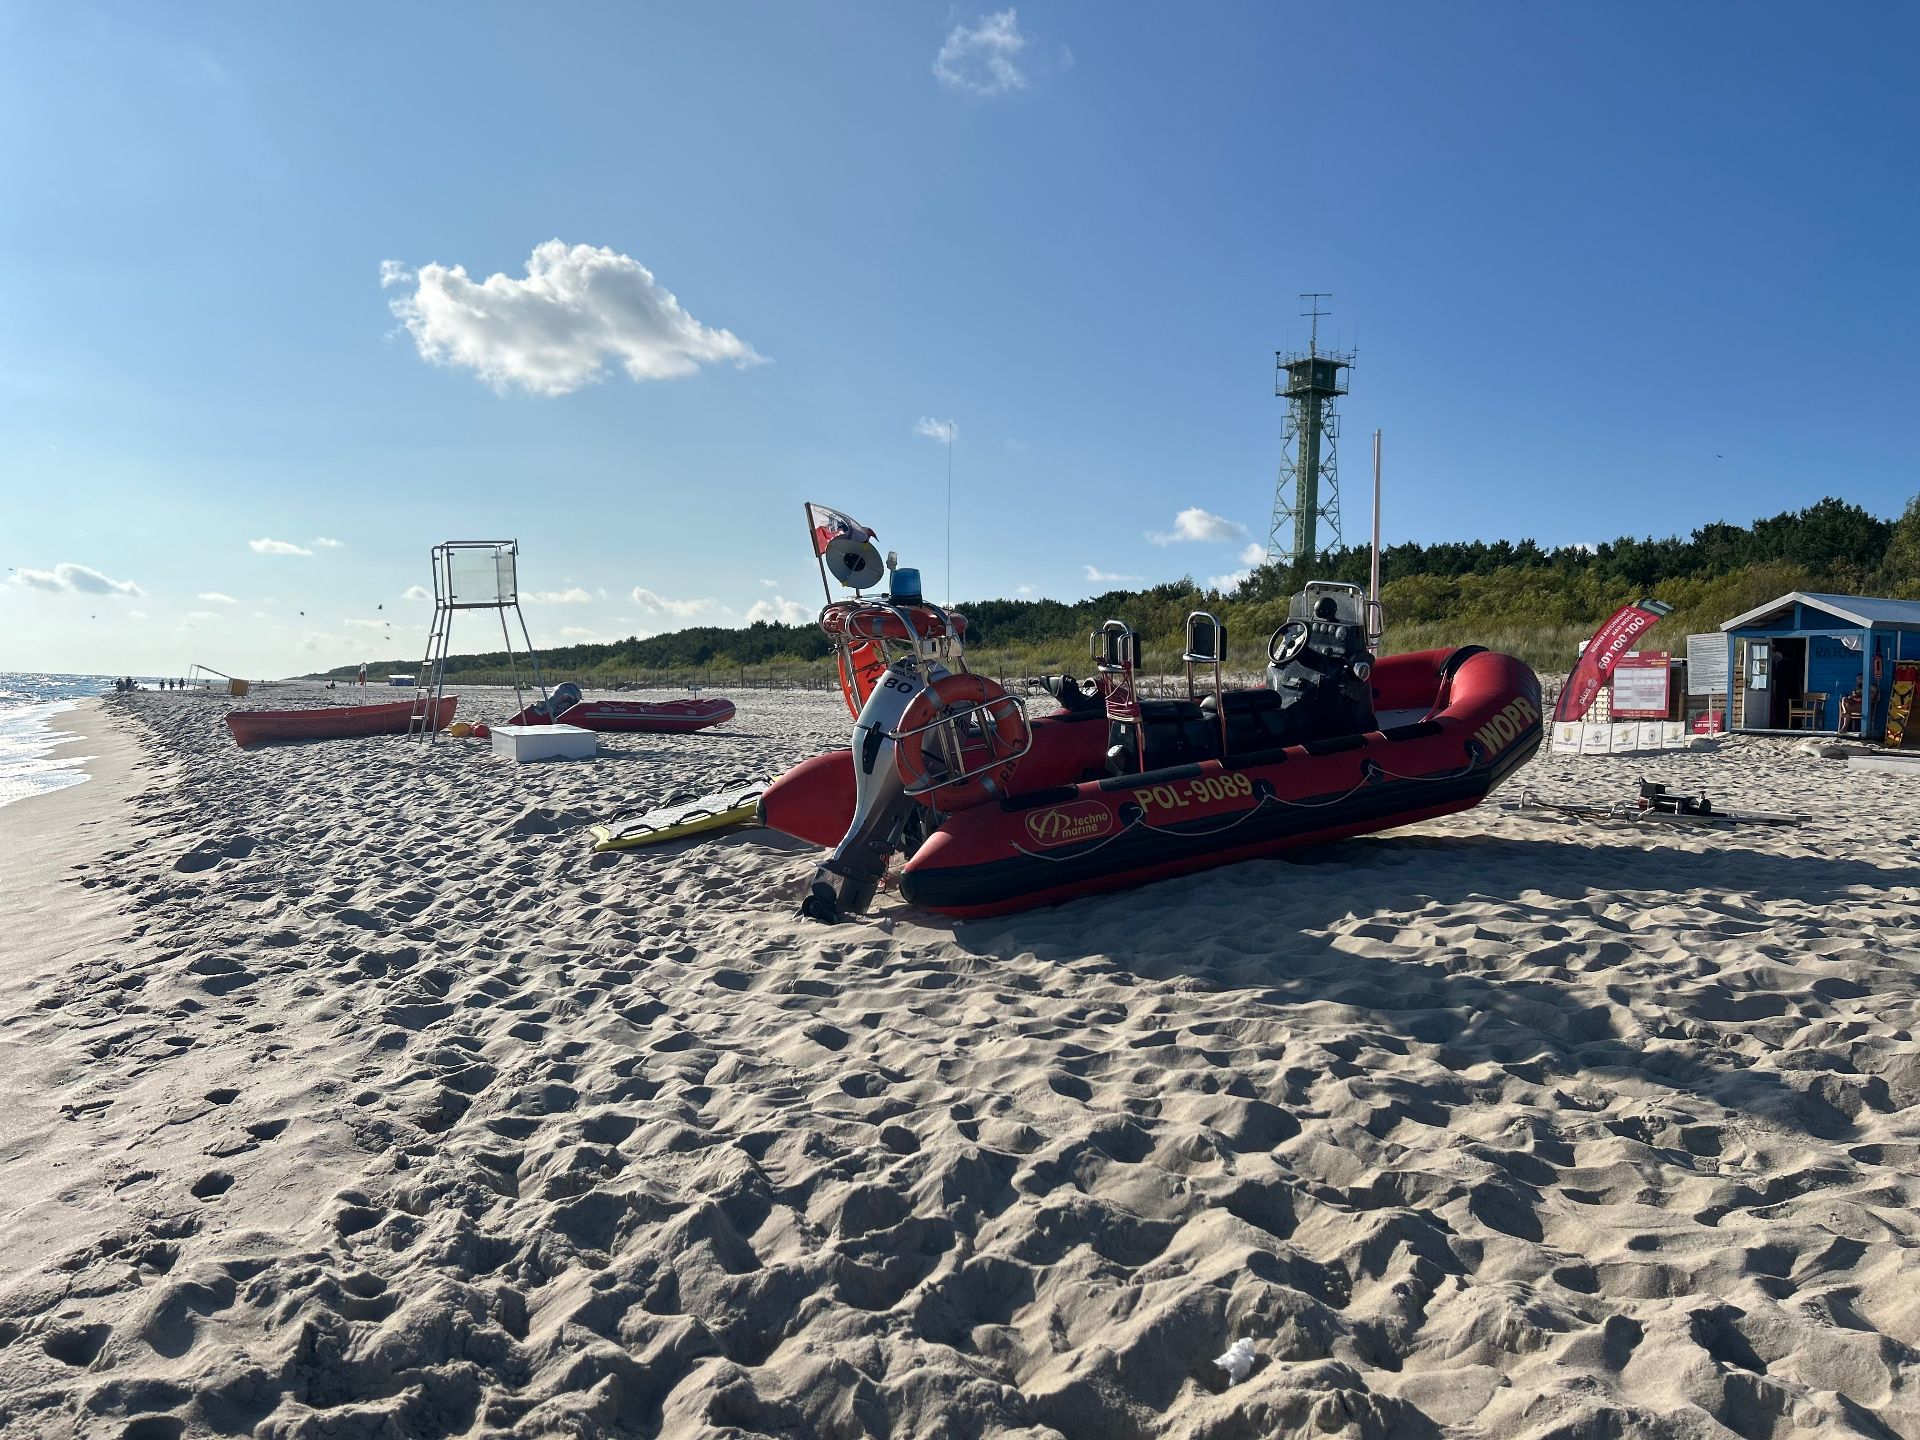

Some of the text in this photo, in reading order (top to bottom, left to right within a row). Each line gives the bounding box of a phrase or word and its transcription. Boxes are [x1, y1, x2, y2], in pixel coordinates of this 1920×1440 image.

[1611, 624, 1622, 637] NAD
[1598, 616, 1645, 670] 601 100 100
[884, 677, 914, 694] 80
[1579, 688, 1592, 706] plus
[1474, 696, 1539, 756] WOPR
[1133, 773, 1253, 813] POL-9089
[1073, 812, 1108, 826] techno
[1061, 823, 1099, 839] marine
